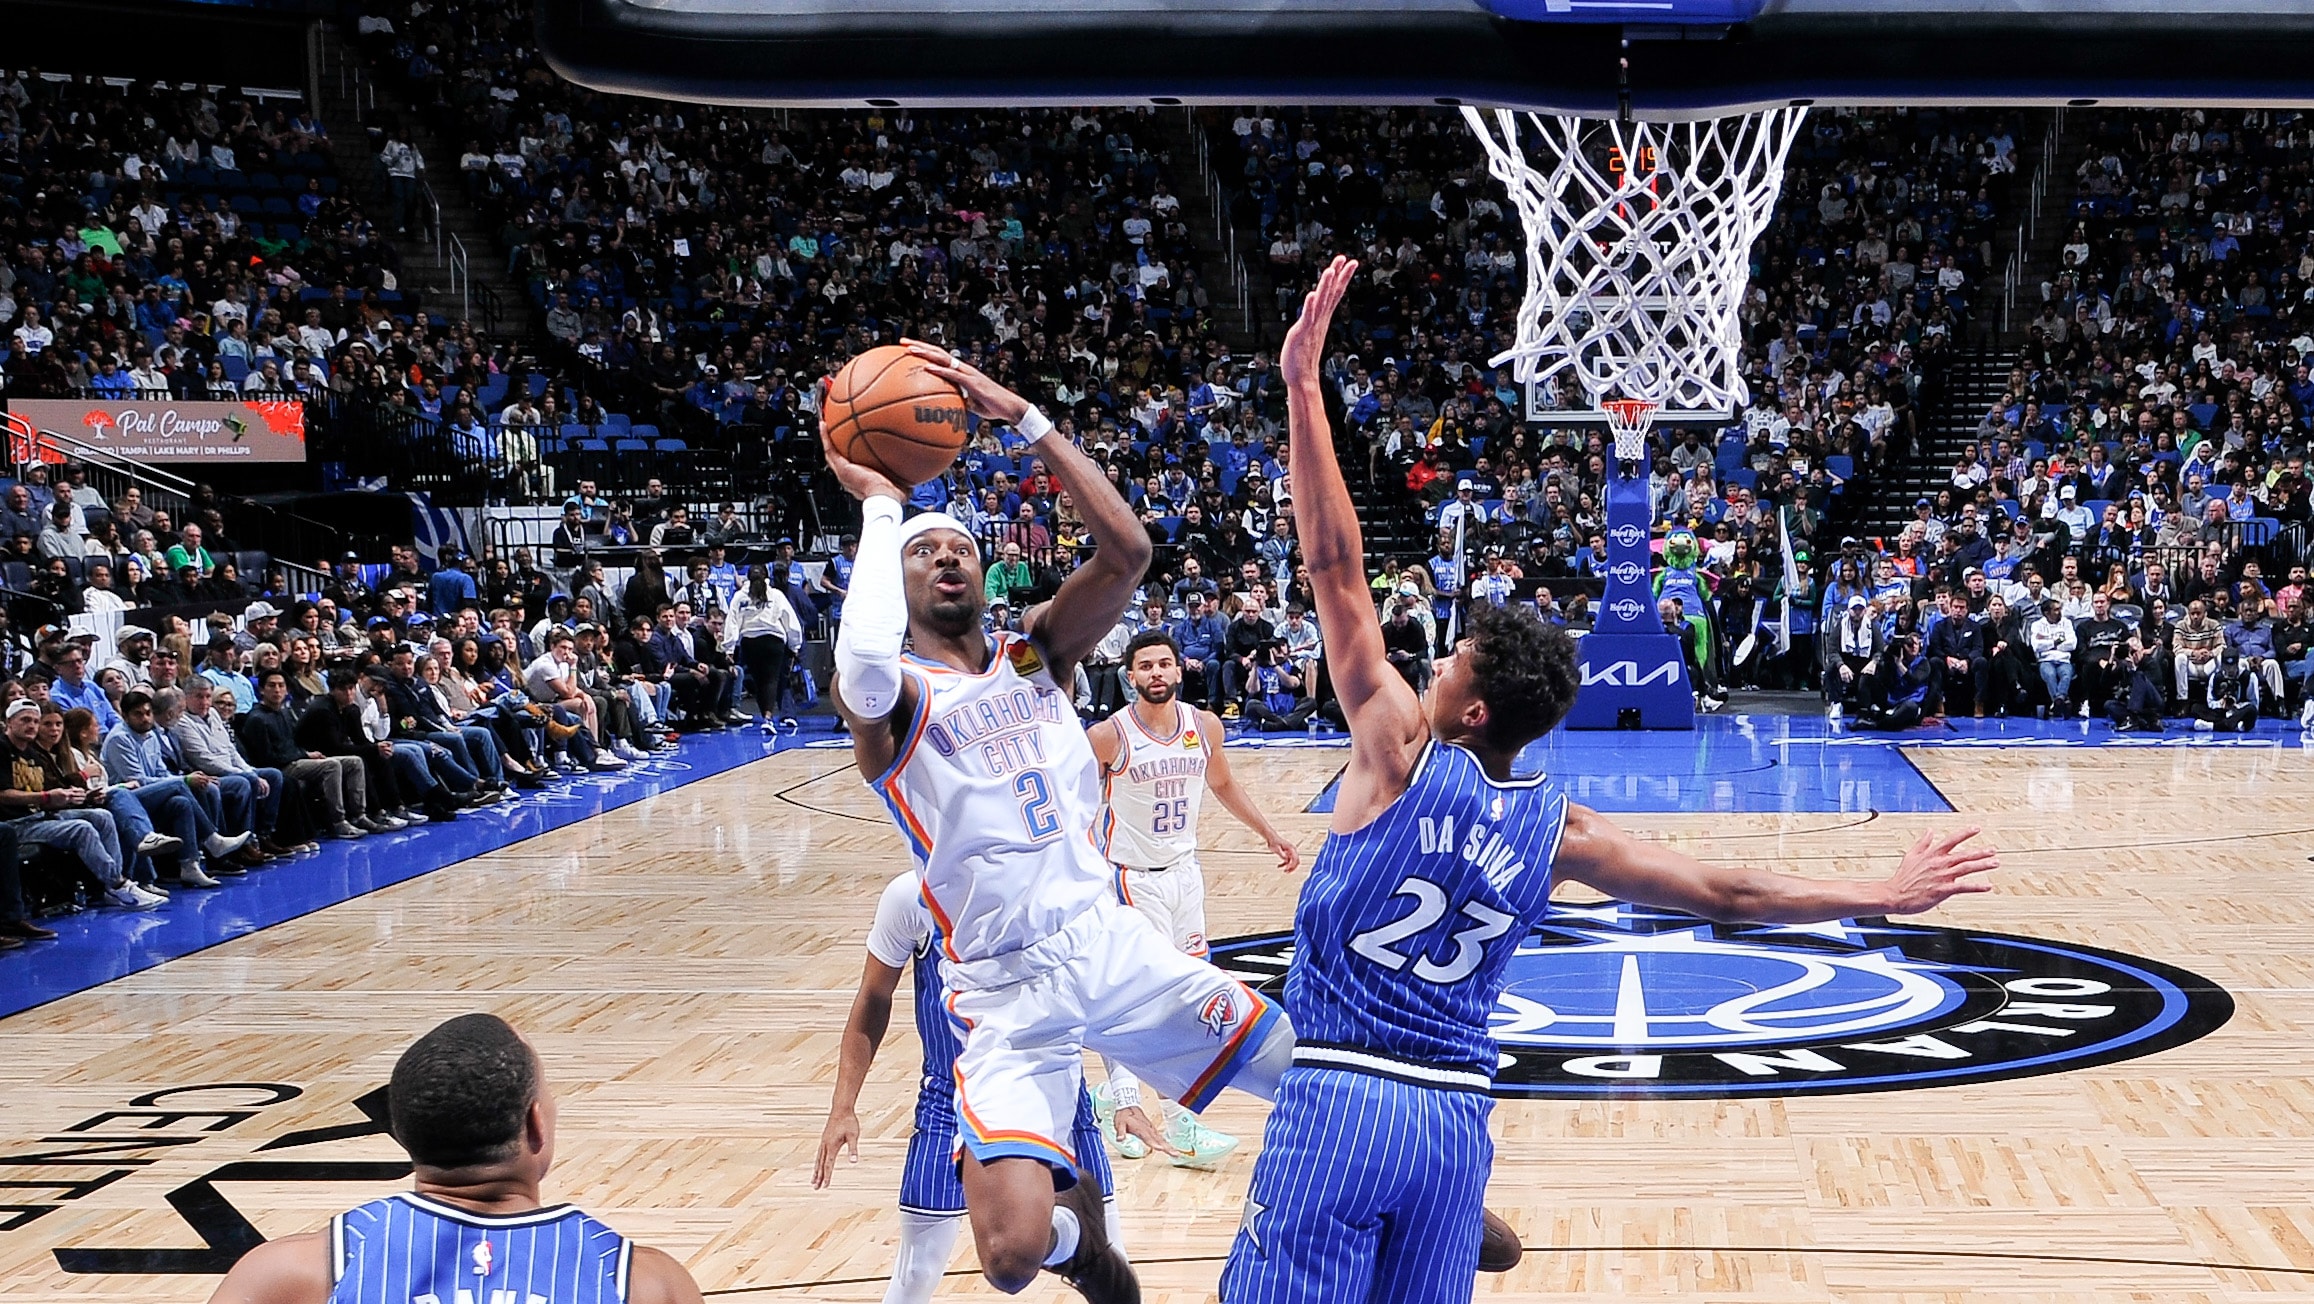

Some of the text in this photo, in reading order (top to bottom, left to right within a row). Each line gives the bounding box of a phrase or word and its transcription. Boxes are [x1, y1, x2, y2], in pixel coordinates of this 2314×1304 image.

[1609, 147, 1658, 172] 219
[1608, 241, 1671, 254] TISOT
[116, 409, 222, 440] Pal Campo
[73, 446, 251, 456] ORLADO TAMPA LAKE MARY DR PHILLIPS
[1578, 660, 1680, 687] KIA
[926, 686, 1063, 757] OKLAHOMA
[981, 726, 1047, 777] CITY
[1129, 756, 1206, 784] OKLAHOMA
[1012, 767, 1064, 843] 2
[1154, 777, 1188, 799] CITY
[1152, 797, 1189, 836] 25
[1418, 814, 1455, 855] DA
[1346, 874, 1518, 986] 23
[1496, 976, 2116, 1080] ORLAND
